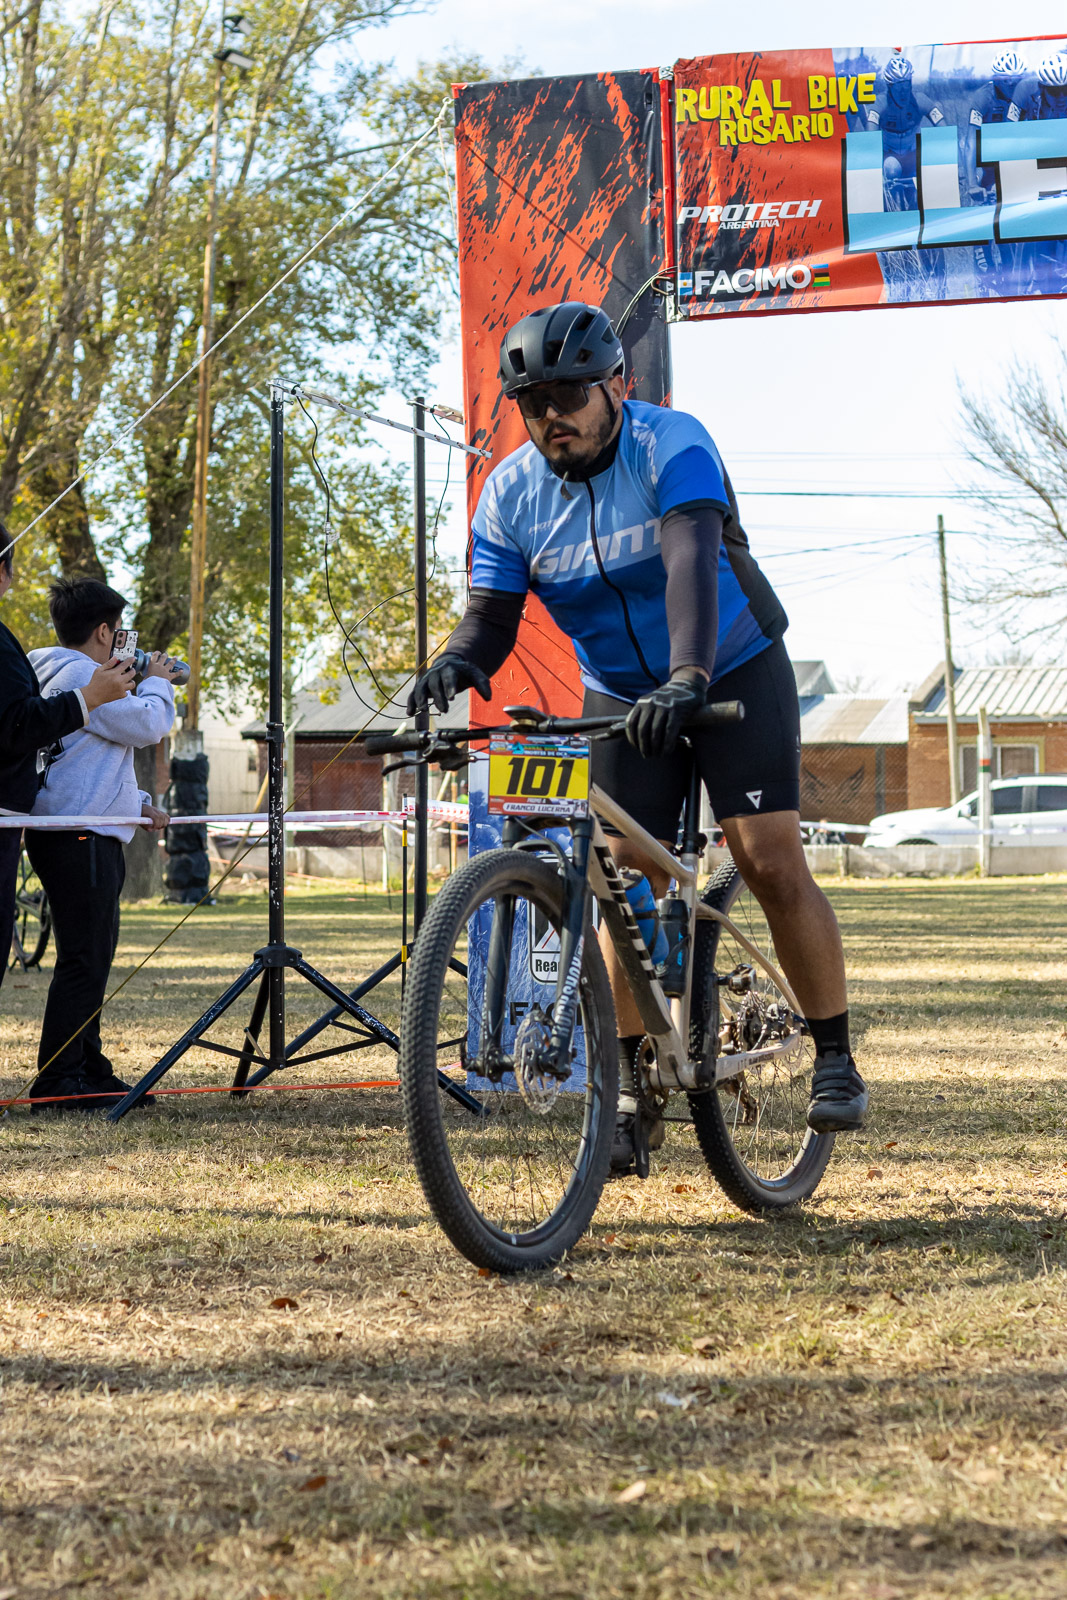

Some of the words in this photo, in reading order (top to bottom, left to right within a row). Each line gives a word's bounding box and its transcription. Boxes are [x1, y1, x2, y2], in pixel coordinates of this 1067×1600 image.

[676, 79, 792, 124] RURAL
[808, 72, 877, 114] BIKE
[719, 112, 834, 147] ROSARIO
[676, 199, 823, 225] PROTECH
[718, 219, 780, 231] ARGENTINA
[694, 264, 812, 296] FACIMO
[532, 516, 661, 574] GIANT
[506, 757, 575, 797] 101
